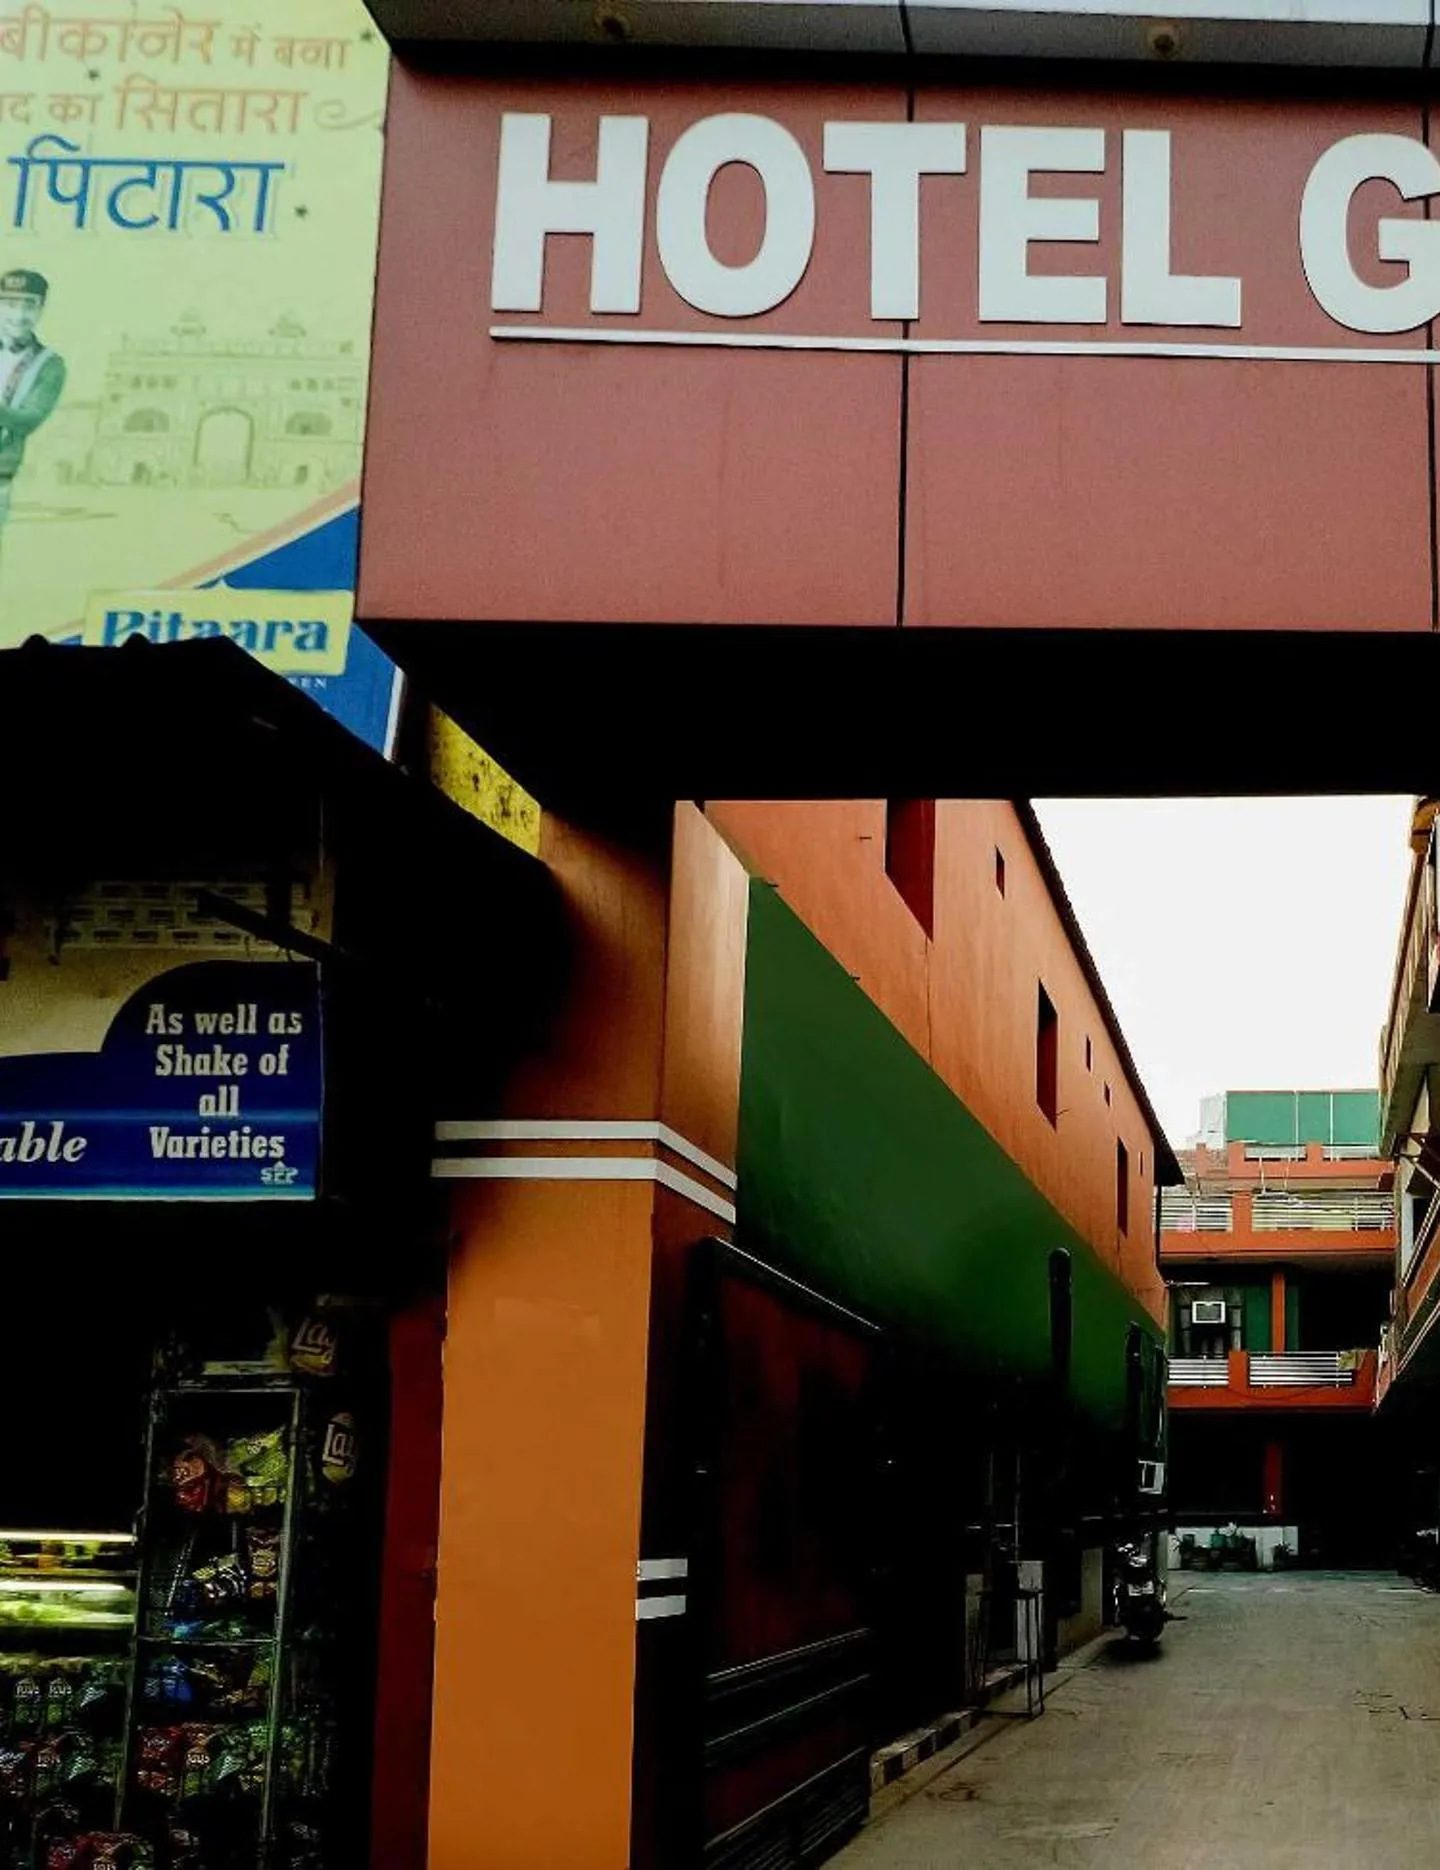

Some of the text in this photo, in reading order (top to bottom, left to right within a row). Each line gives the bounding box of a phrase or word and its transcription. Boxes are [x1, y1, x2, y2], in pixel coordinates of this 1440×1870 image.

[48, 95, 103, 125] का
[110, 72, 308, 134] सितारा
[7, 134, 285, 232] पिटारा
[491, 112, 1242, 328] HOTEL
[145, 1003, 302, 1035] As well as
[155, 1044, 290, 1076] Shake of
[199, 1085, 239, 1116] all
[149, 1126, 286, 1158] Varieties
